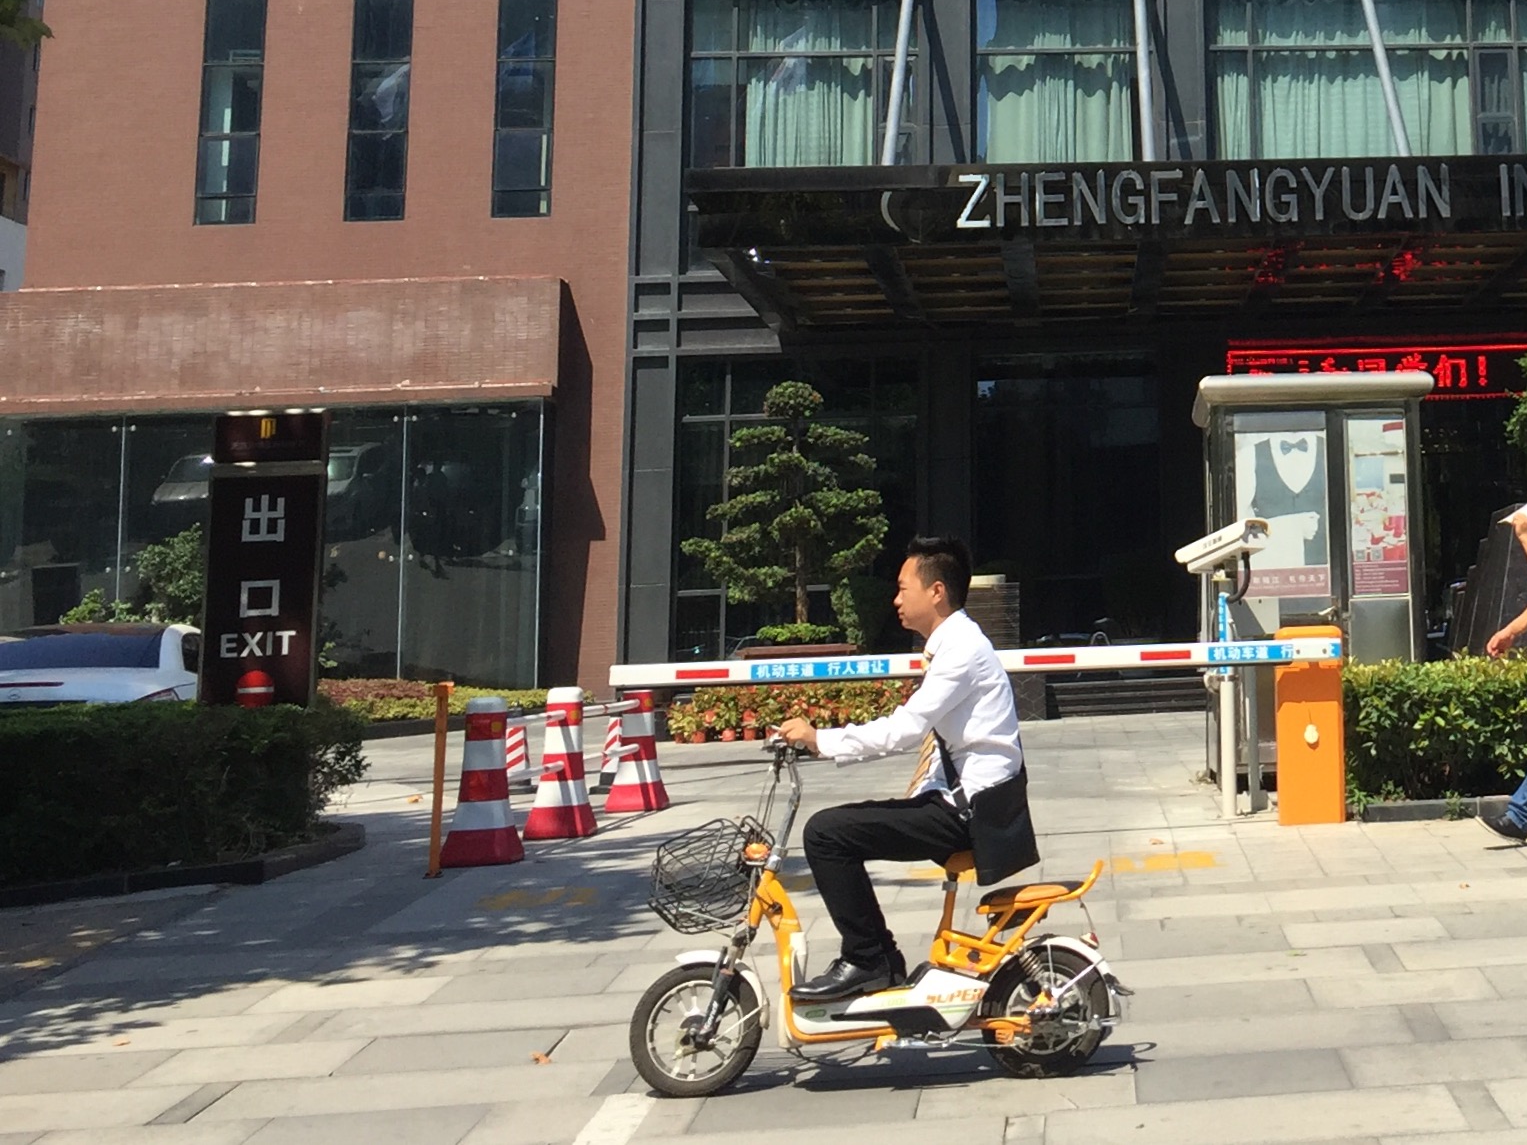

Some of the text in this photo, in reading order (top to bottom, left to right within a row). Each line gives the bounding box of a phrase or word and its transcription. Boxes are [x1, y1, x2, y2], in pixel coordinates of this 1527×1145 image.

[956, 162, 1450, 228] ZHENGFANGYUAN
[240, 494, 286, 619] 出口
[219, 630, 297, 659] EXIT
